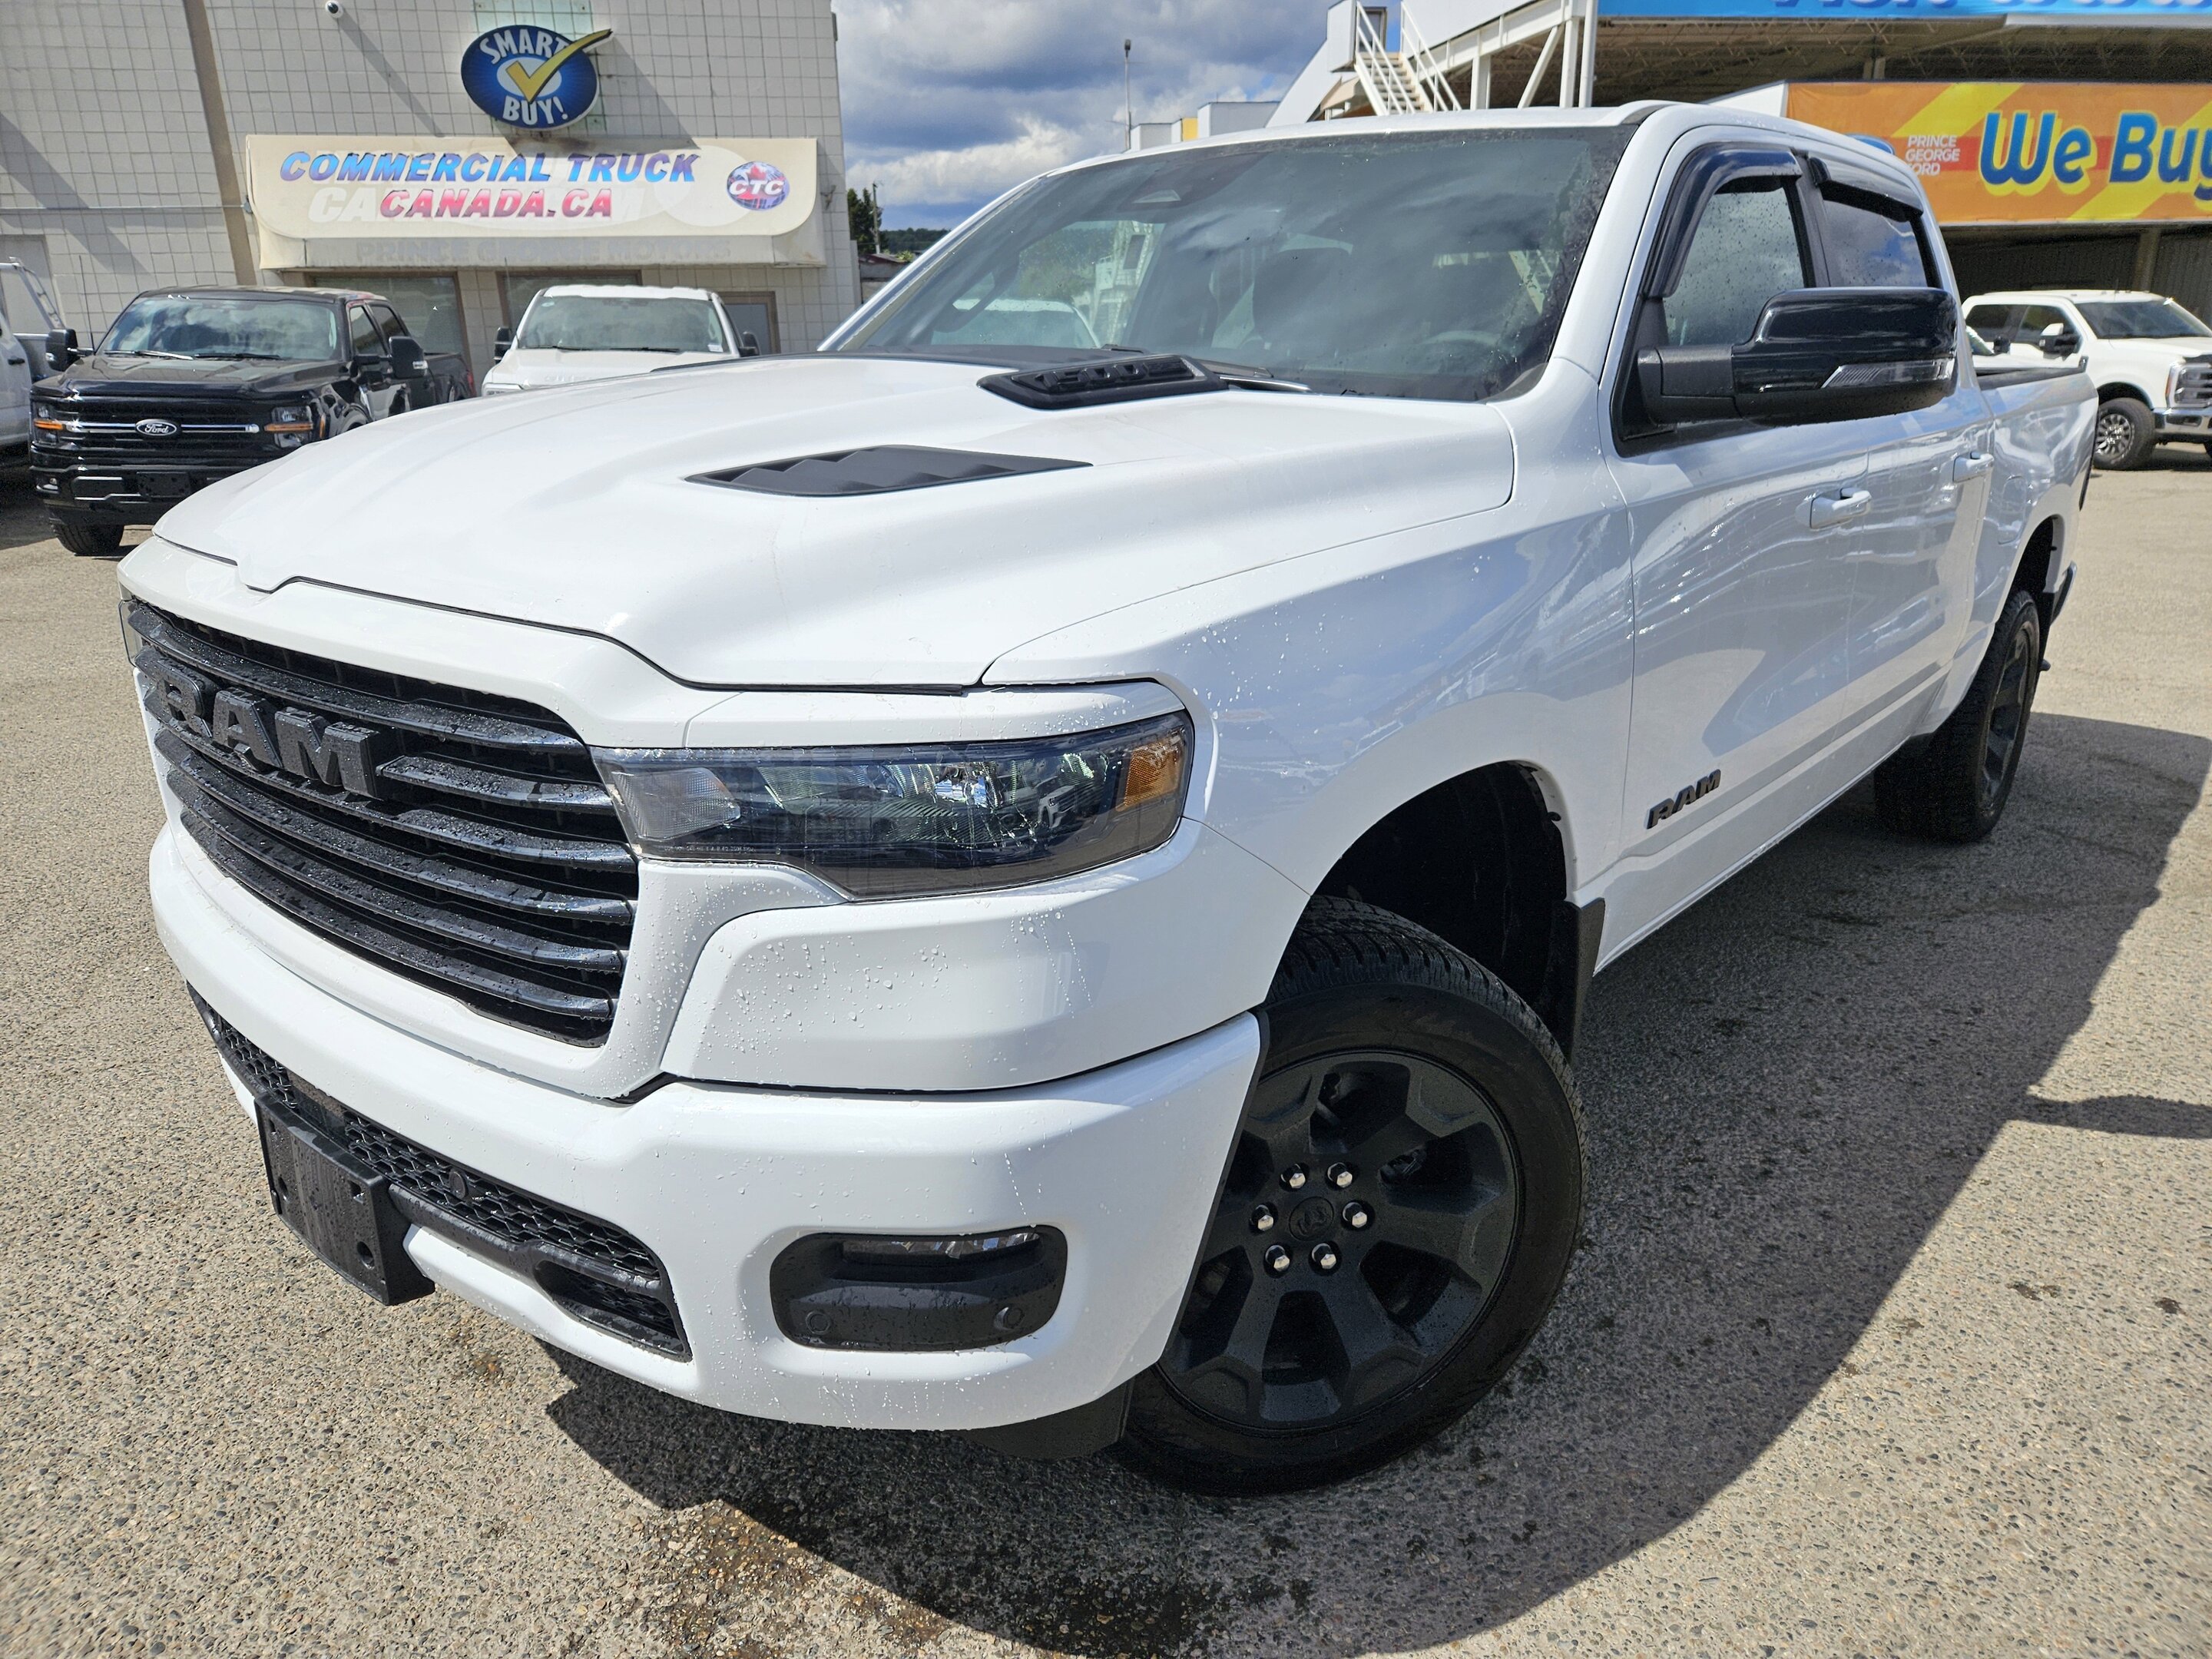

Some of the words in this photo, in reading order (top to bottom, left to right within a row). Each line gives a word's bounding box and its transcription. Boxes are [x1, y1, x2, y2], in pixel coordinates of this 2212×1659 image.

[479, 28, 569, 65] SMART
[502, 95, 568, 125] BUY!
[1905, 148, 1961, 162] GEORGE
[1907, 134, 1957, 147] PRINCE
[1979, 111, 2093, 187] We
[280, 151, 551, 182] COMMERCIAL
[567, 153, 700, 182] TRUCK
[729, 180, 784, 195] CTC
[379, 188, 612, 219] CANADA.CA
[144, 424, 169, 433] Ford
[155, 663, 381, 798] RAM
[1644, 769, 1721, 830] RAM
